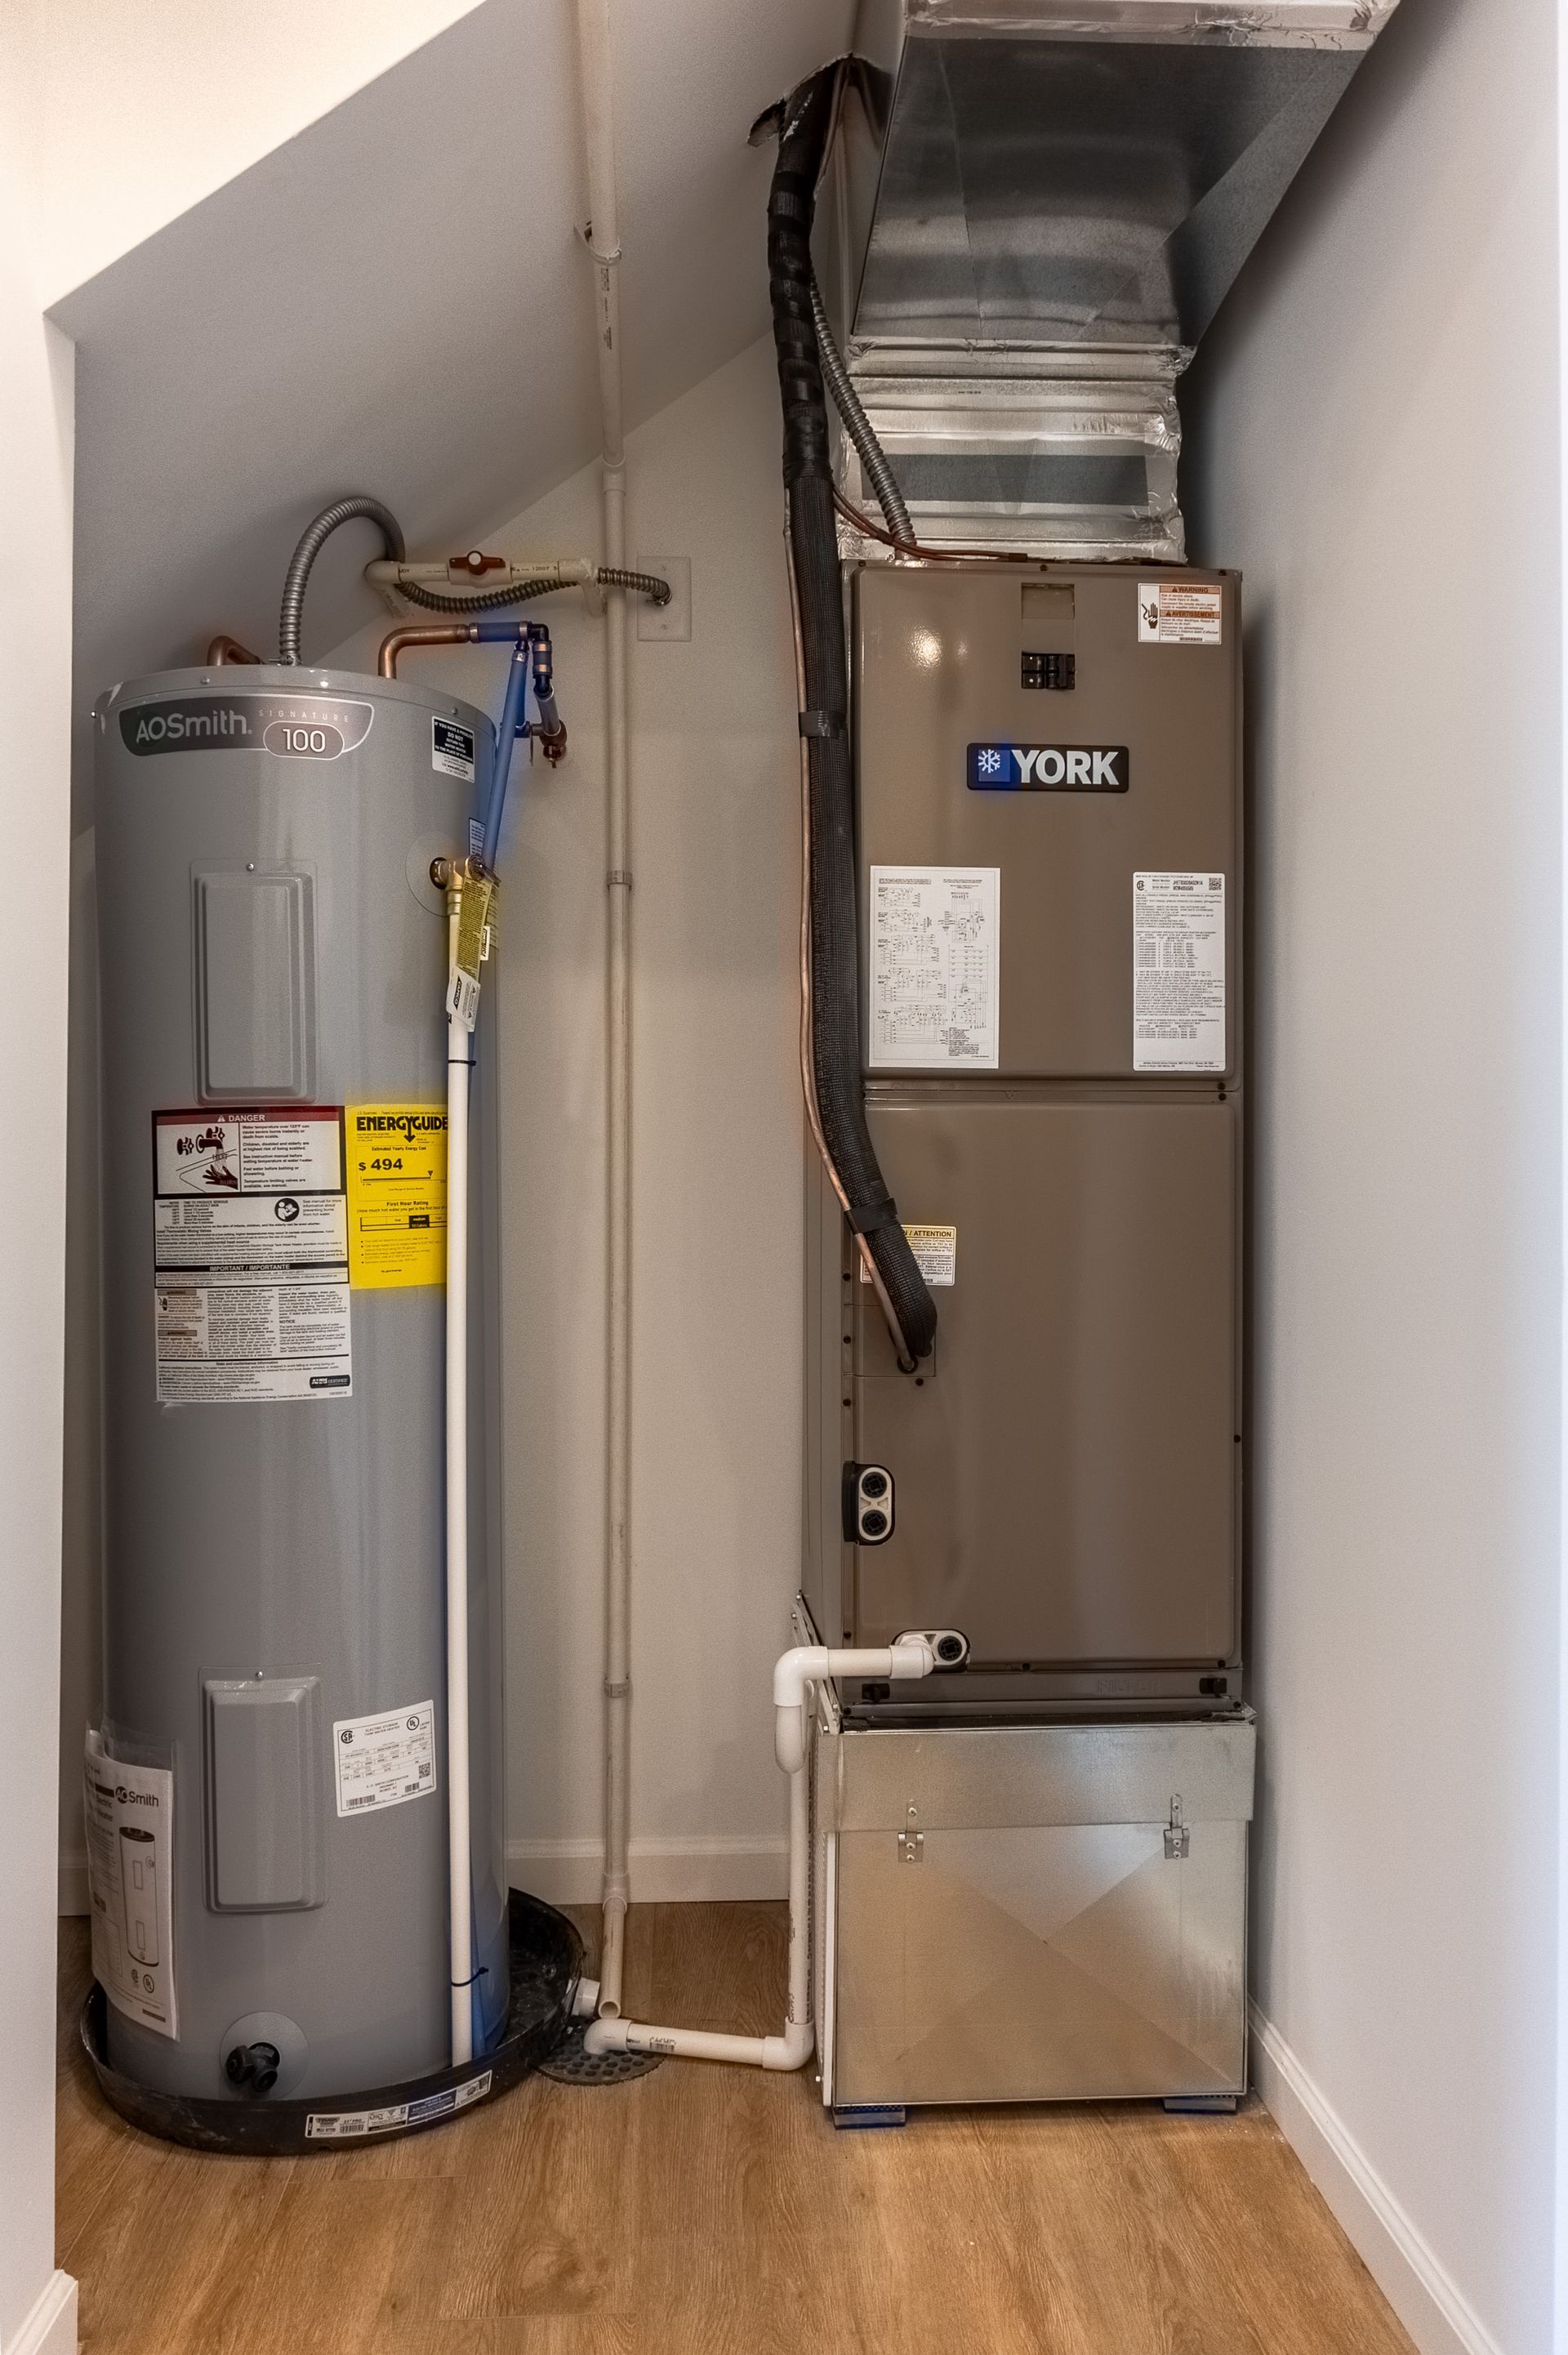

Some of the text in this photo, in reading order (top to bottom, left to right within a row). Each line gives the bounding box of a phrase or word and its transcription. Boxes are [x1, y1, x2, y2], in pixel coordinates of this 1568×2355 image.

[258, 708, 350, 724] SIGNATURE
[282, 728, 326, 753] 100
[1011, 749, 1120, 786] YORK
[228, 1114, 266, 1122] DANGER
[356, 1116, 448, 1131] ENERGYGUIDE
[359, 1157, 403, 1171] $ 494
